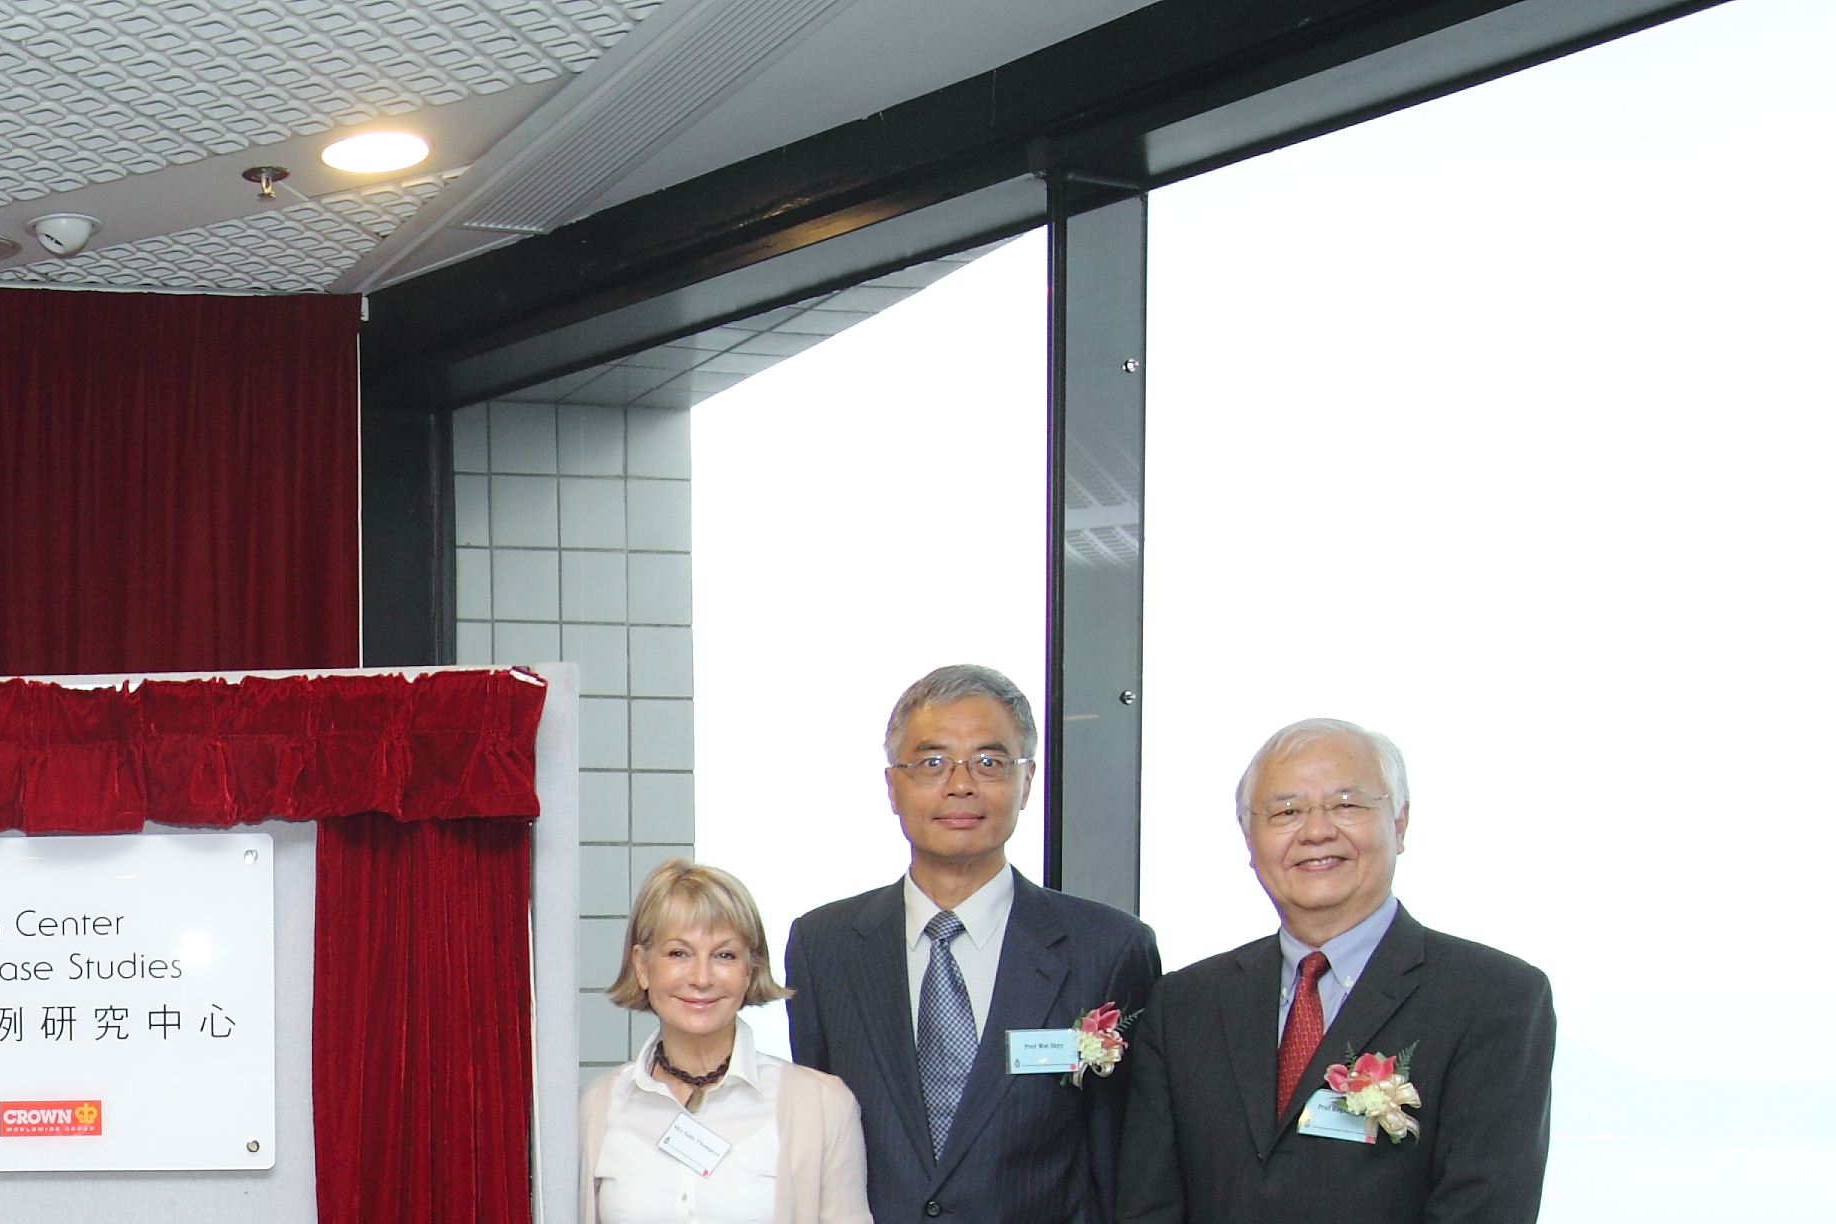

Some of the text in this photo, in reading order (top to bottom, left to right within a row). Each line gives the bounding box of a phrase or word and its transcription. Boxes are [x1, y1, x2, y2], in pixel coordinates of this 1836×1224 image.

[15, 908, 125, 938] Center
[68, 951, 183, 981] Studies
[3, 1110, 72, 1125] CROWN
